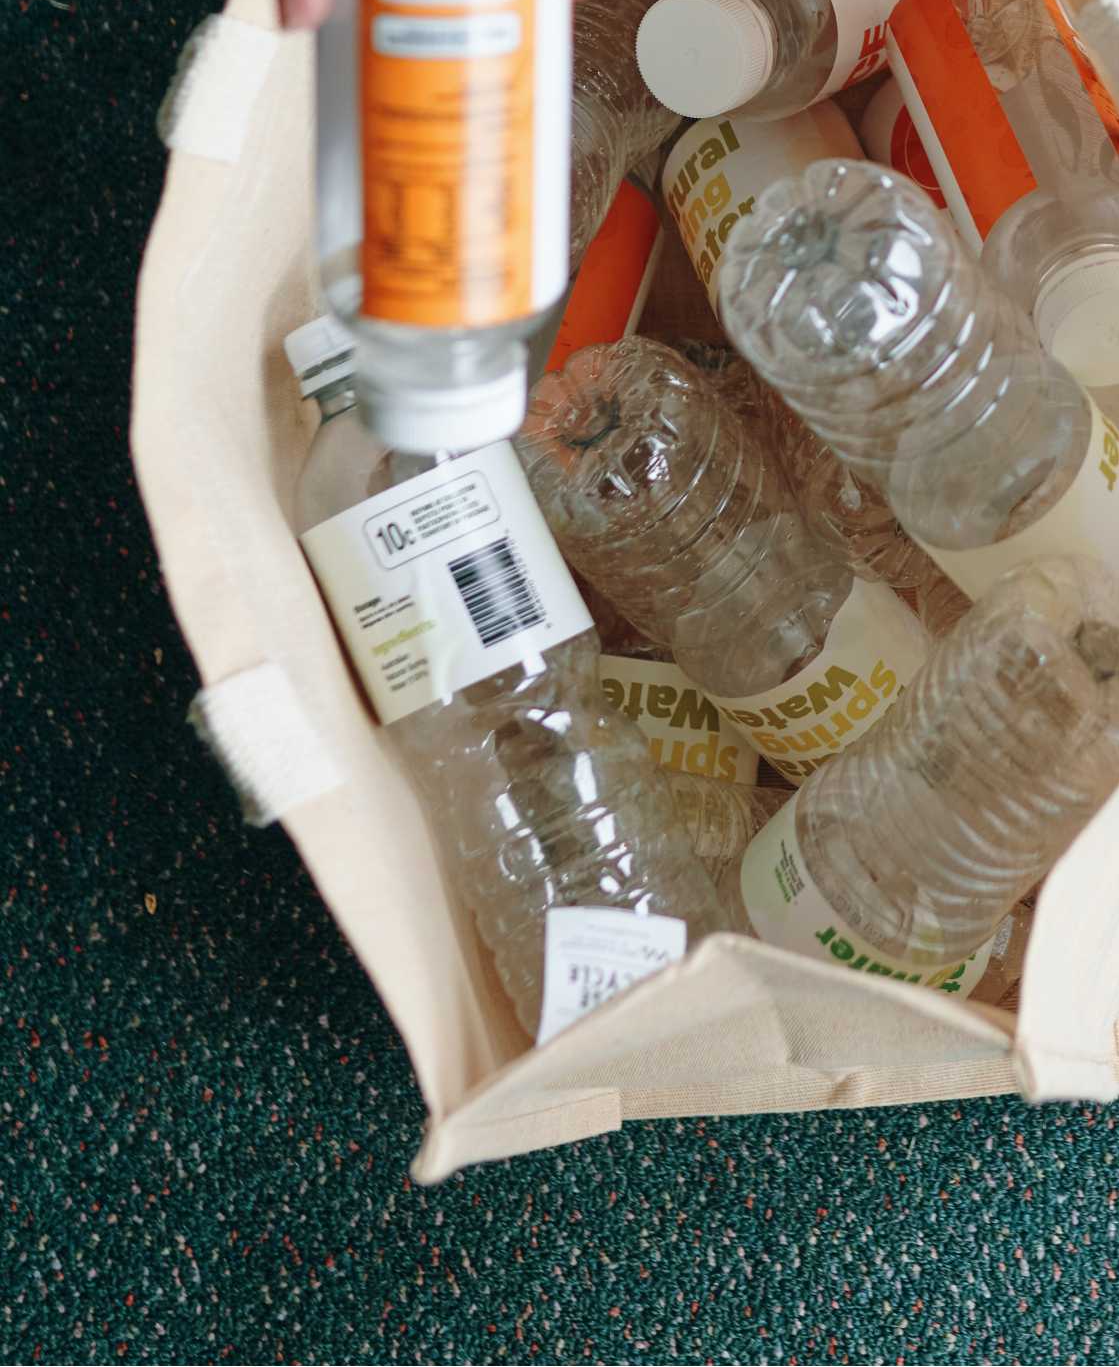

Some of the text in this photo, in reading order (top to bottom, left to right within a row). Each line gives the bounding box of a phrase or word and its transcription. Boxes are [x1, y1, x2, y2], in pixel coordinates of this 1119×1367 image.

[697, 196, 756, 284] ater
[376, 521, 417, 555] 10c
[602, 678, 720, 733] Wate
[751, 659, 897, 755] spring
